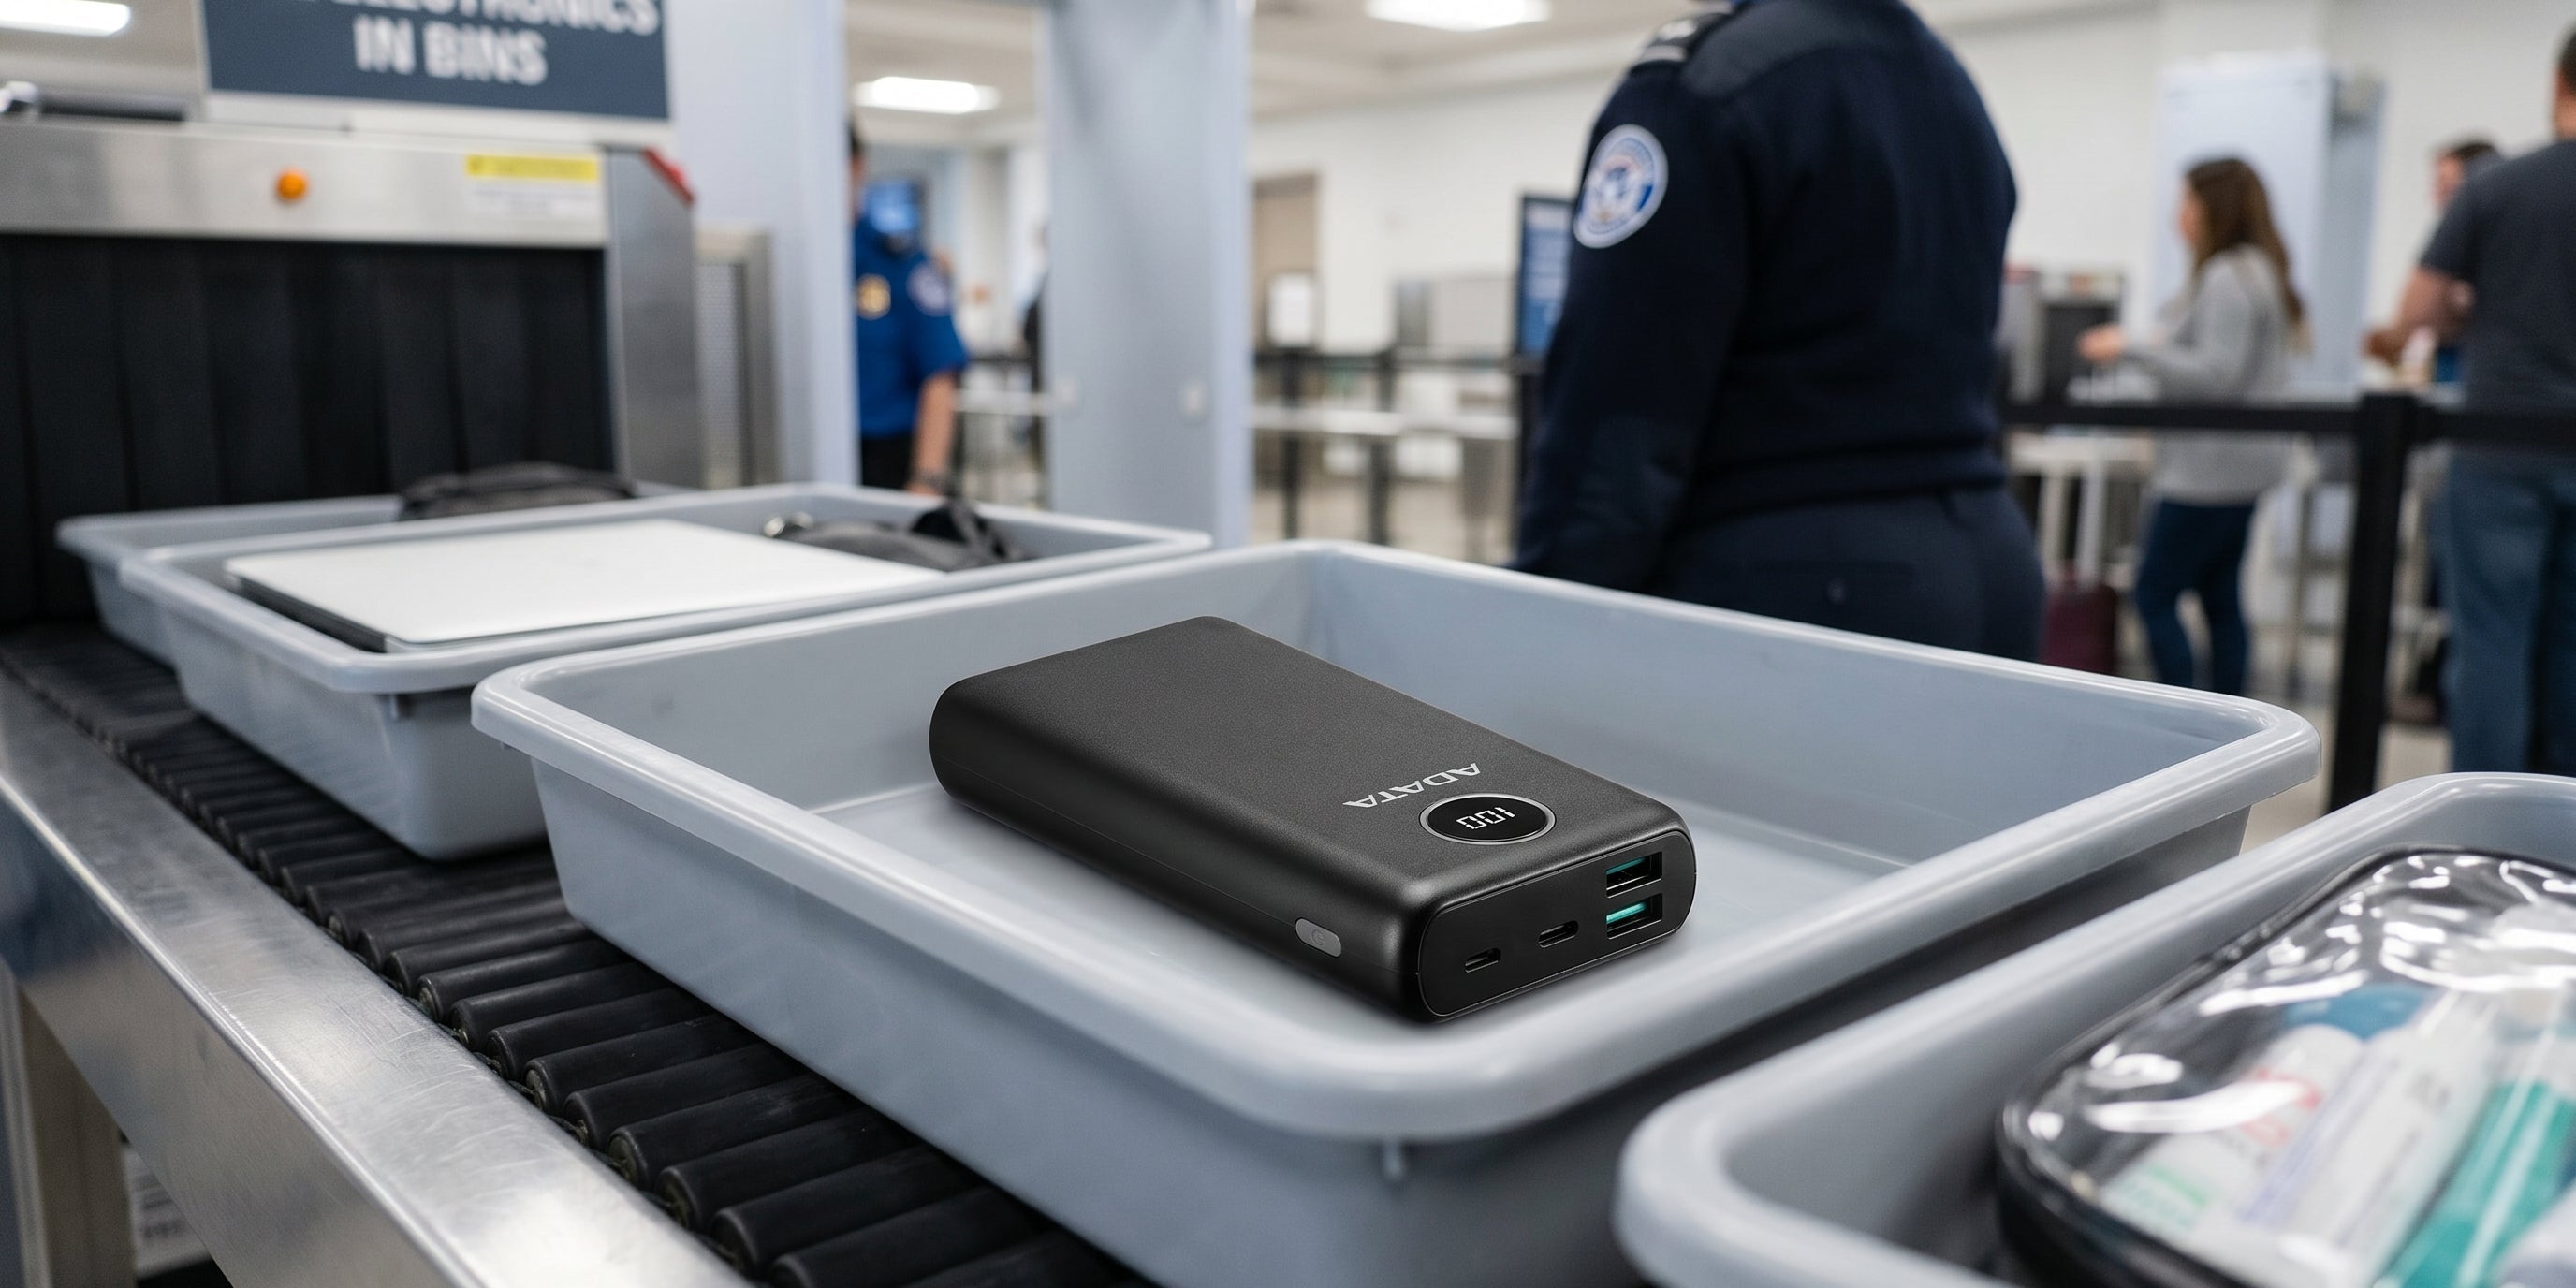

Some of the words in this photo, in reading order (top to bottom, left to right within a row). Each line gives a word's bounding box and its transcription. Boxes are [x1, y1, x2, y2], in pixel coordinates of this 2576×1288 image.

[352, 14, 416, 74] IN
[422, 21, 548, 85] BINS
[1342, 762, 1481, 808] ADATA
[1456, 807, 1515, 830] 100
